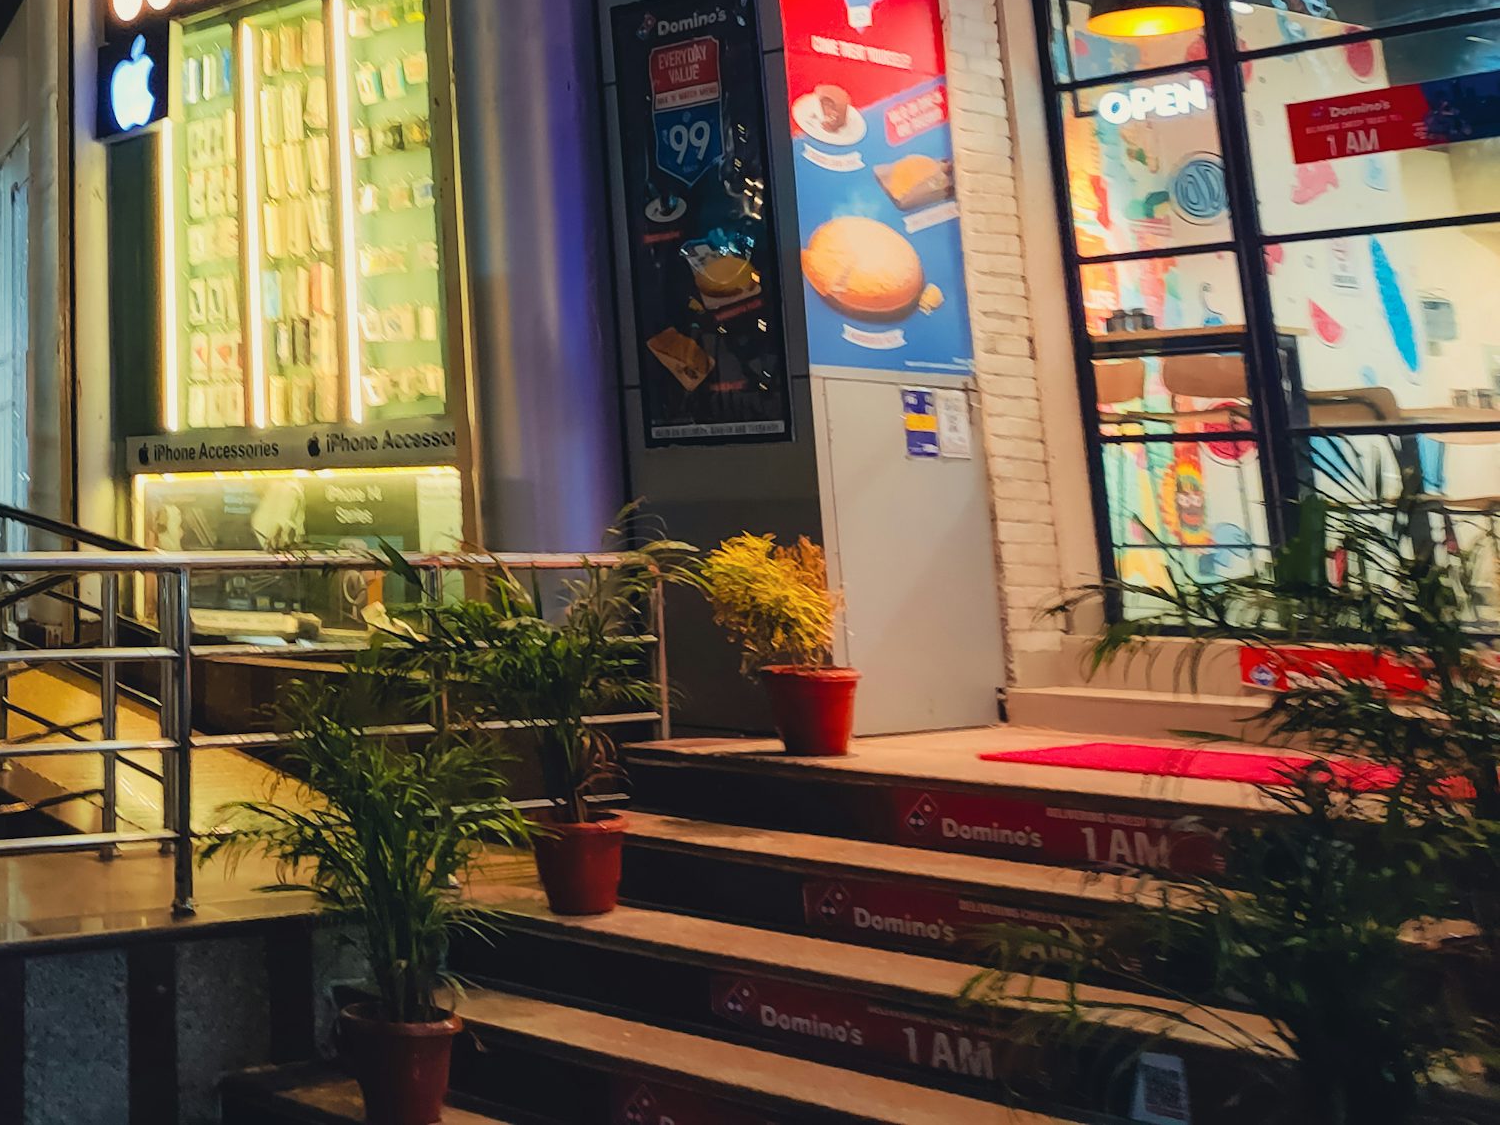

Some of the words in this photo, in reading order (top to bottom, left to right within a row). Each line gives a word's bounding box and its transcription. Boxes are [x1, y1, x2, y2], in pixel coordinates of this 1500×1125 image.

[657, 6, 727, 36] Domino's
[658, 44, 707, 70] EVERYDAY
[668, 63, 700, 85] VALUE
[1099, 79, 1208, 125] OPEN
[1328, 99, 1391, 118] Domino's
[669, 121, 711, 165] 99
[1326, 133, 1338, 156] 1
[1346, 127, 1381, 154] AM
[154, 442, 196, 463] iPhone
[198, 439, 280, 461] Accessories
[326, 433, 378, 454] iPhone
[940, 817, 1043, 849] Domino's
[1079, 827, 1100, 860] 1
[1108, 828, 1171, 869] AM
[852, 906, 956, 942] Domino's
[759, 1004, 864, 1046] Domino's
[902, 1027, 920, 1065] 1
[931, 1031, 995, 1080] AM
